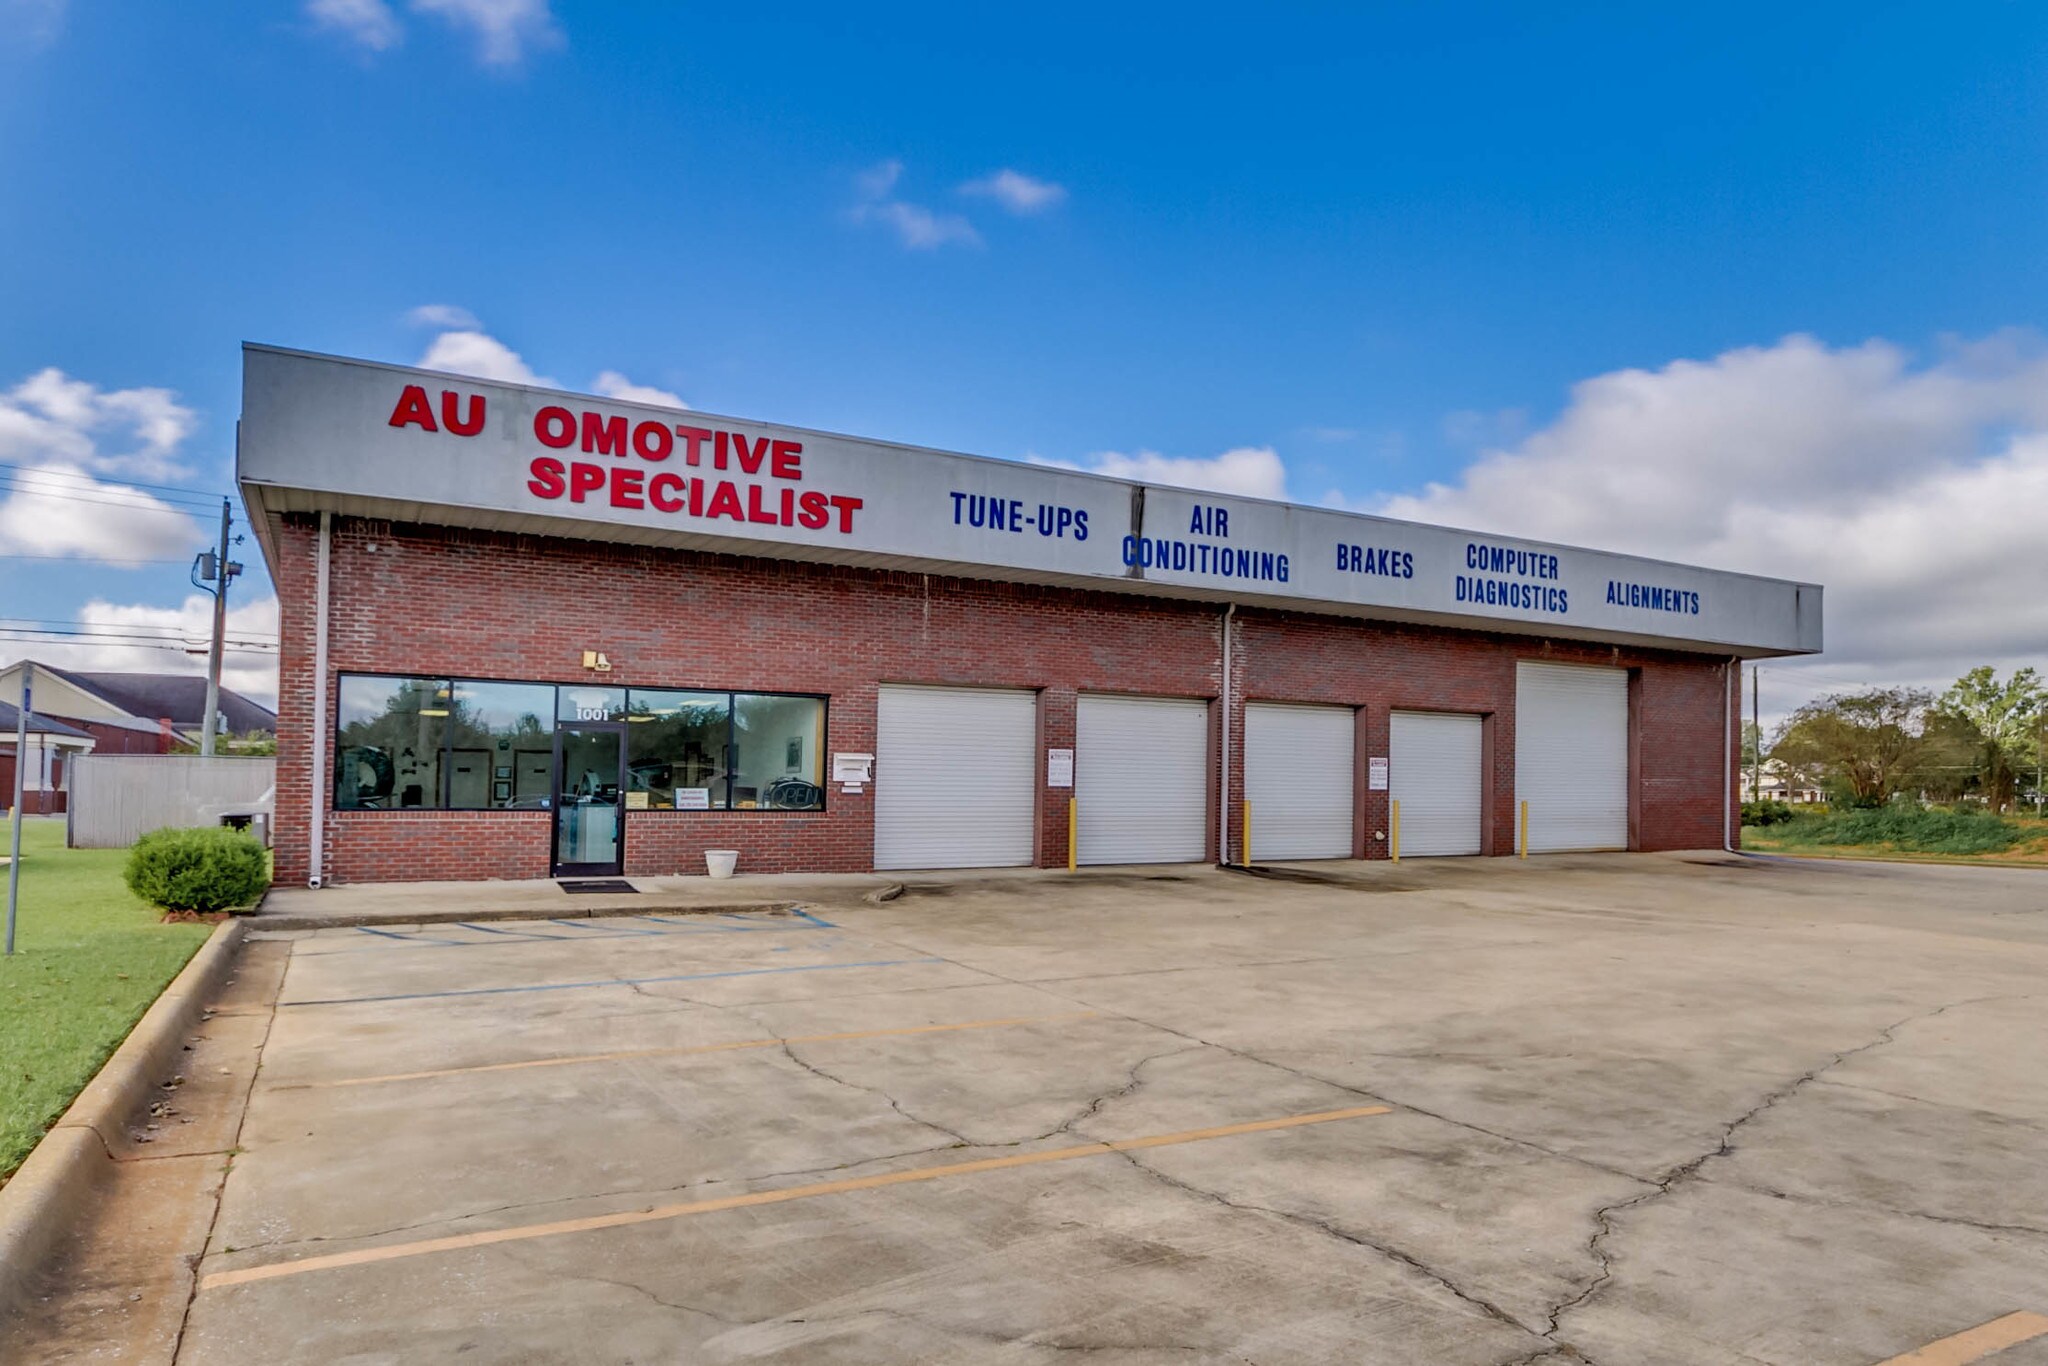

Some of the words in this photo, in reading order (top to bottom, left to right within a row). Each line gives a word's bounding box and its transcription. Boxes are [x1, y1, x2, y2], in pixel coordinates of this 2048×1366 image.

[527, 457, 864, 533] SPECIALIST
[950, 491, 1089, 542] TUNE-UPS
[1189, 504, 1229, 538] AIR
[1122, 534, 1289, 583] CONDITIONING
[1336, 543, 1414, 579] BRAKES
[1466, 543, 1558, 580] COMPUTER
[1455, 575, 1568, 614] DIAGNOSTICS
[1606, 581, 1700, 615] ALIGNMENTS
[576, 708, 608, 721] 1001
[771, 786, 819, 804] OPEN
